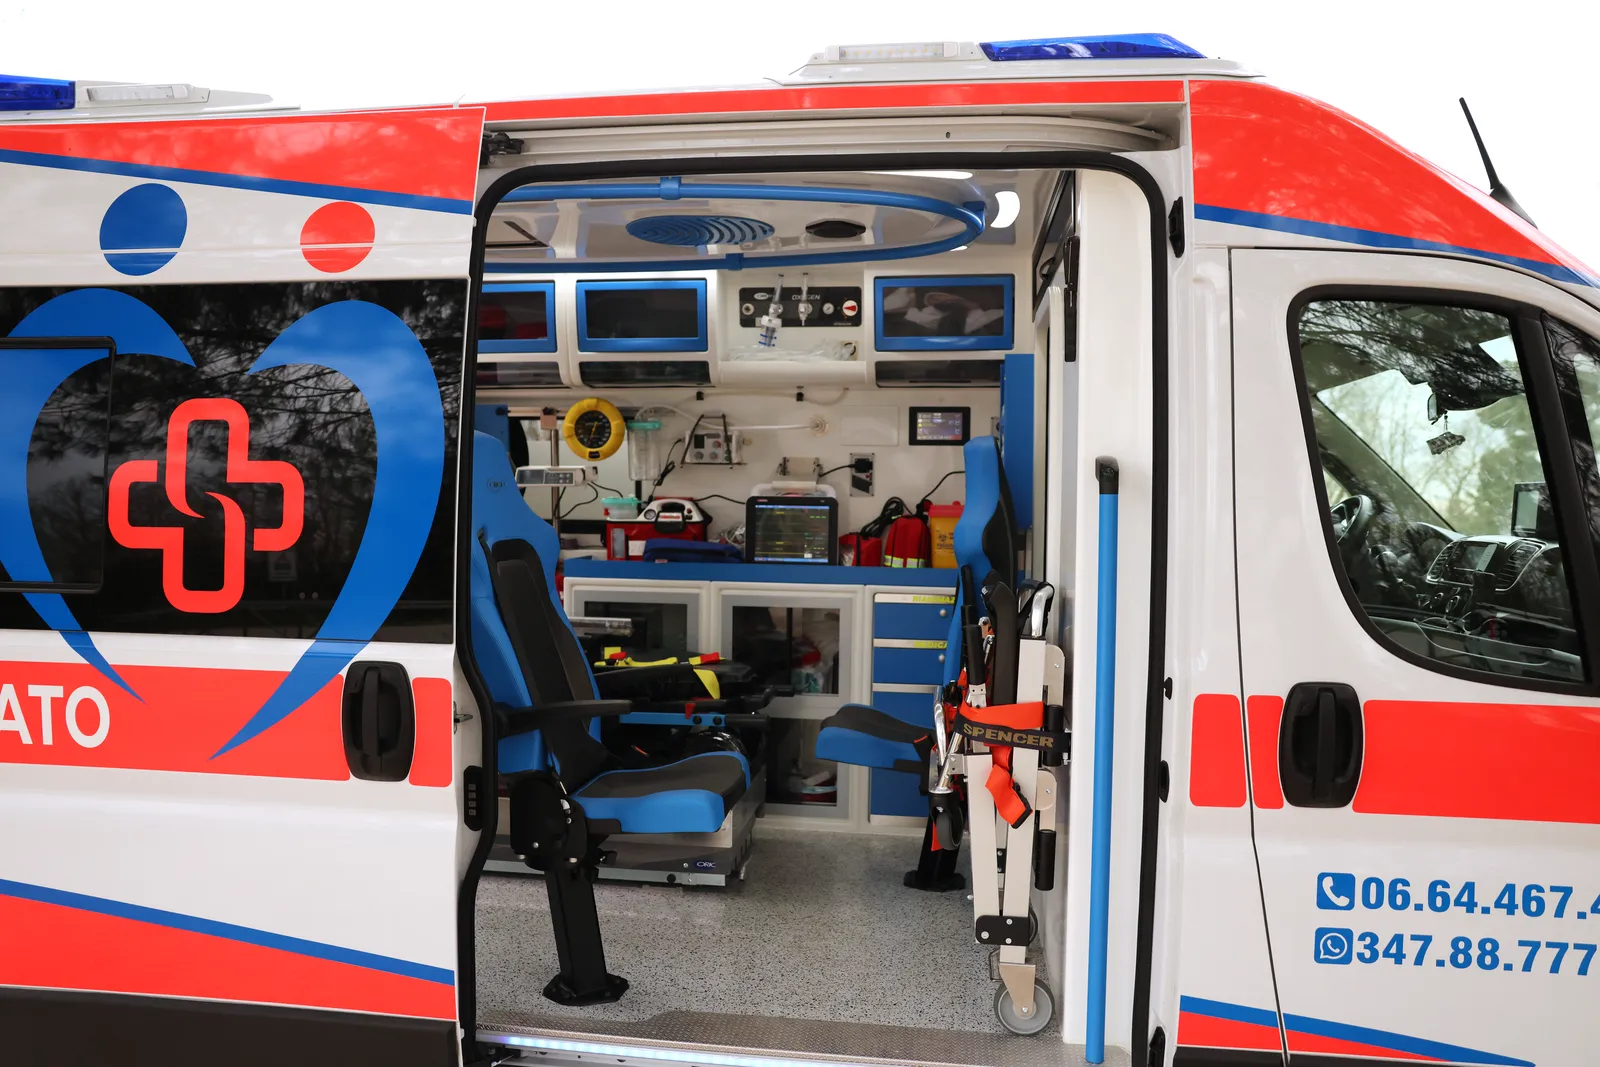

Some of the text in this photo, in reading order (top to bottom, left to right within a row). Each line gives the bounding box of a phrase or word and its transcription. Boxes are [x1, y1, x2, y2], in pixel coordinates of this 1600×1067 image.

[0, 683, 111, 748] ATO
[963, 723, 1054, 748] SPENCER
[1356, 931, 1597, 976] 347.88.777
